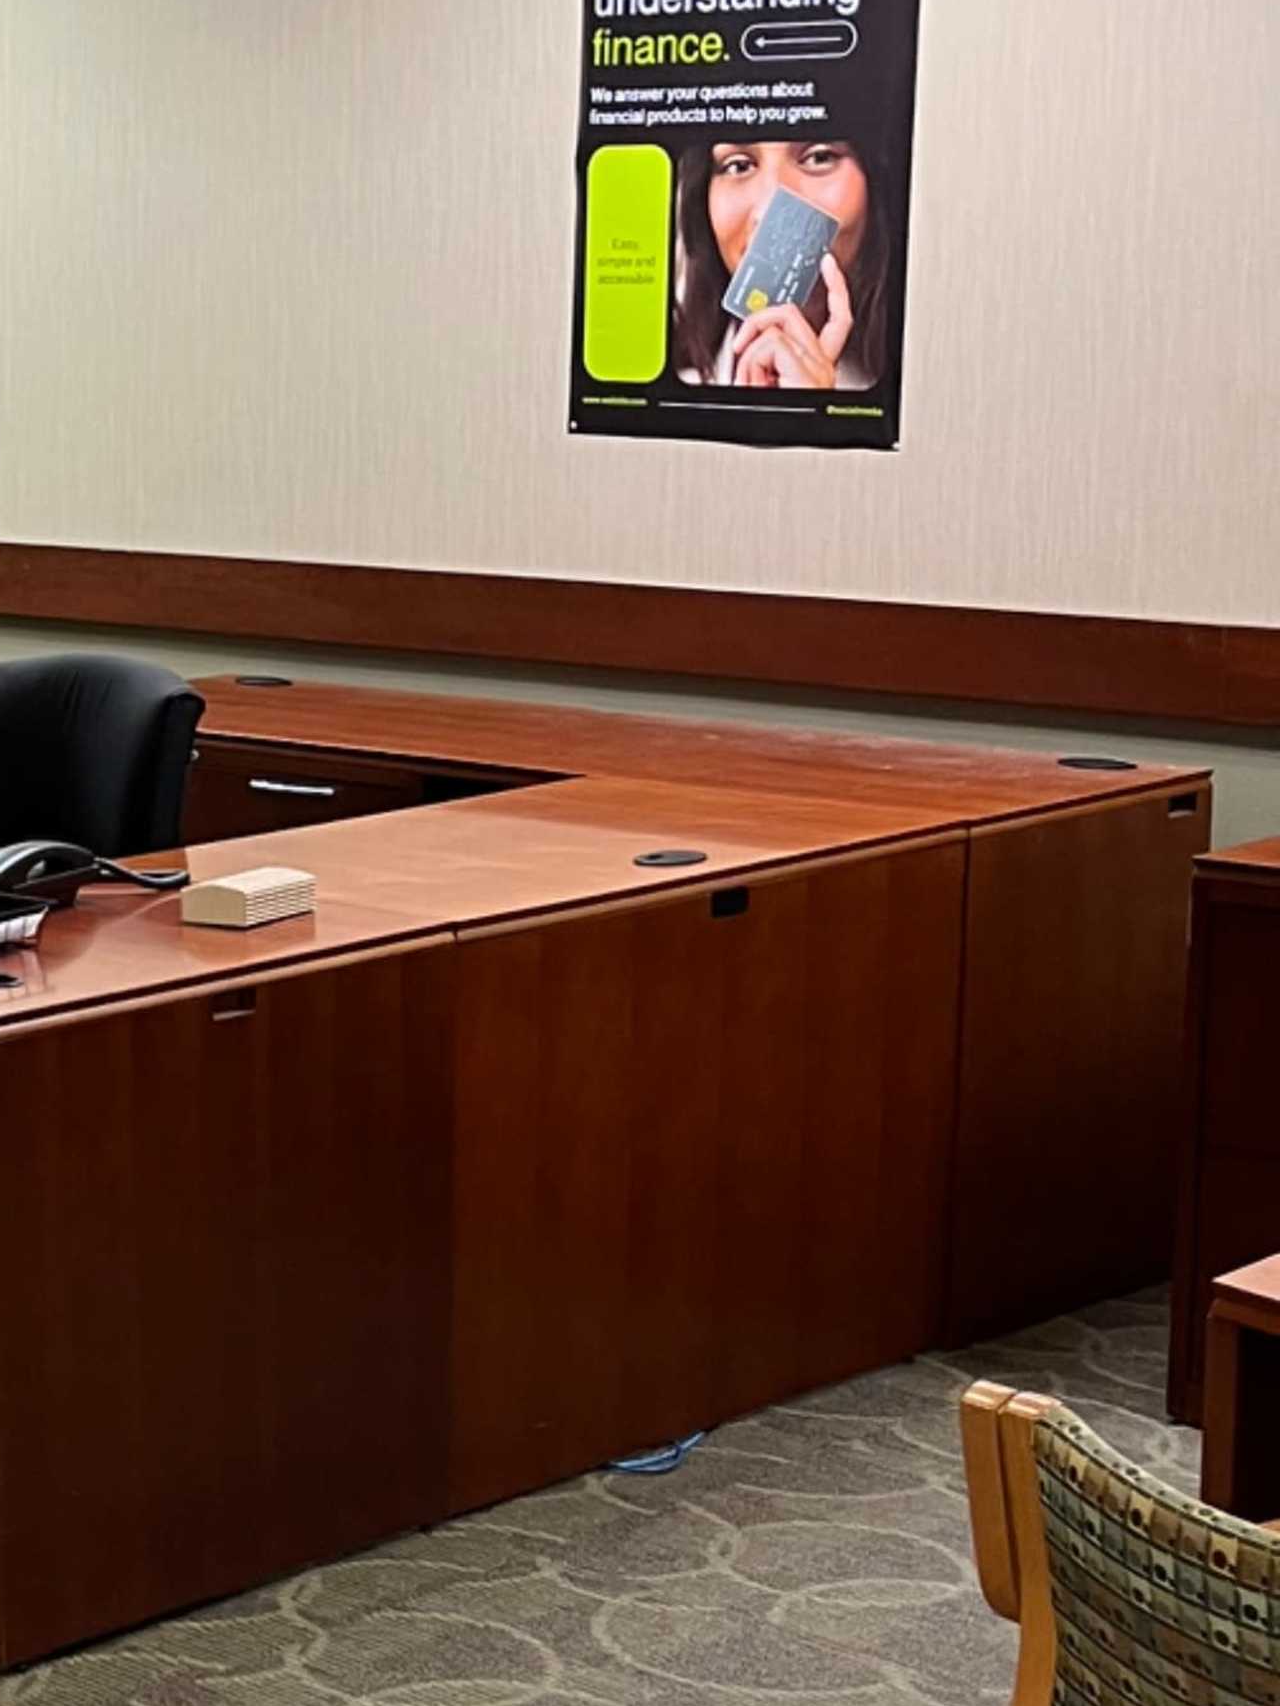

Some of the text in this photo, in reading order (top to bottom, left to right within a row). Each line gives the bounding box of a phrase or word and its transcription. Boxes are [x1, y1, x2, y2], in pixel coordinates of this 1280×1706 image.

[592, 27, 730, 66] finance.
[590, 81, 814, 104] We answer your questions about
[589, 108, 646, 125] financial
[646, 107, 707, 127] products
[709, 107, 724, 122] to
[726, 105, 757, 125] help
[758, 107, 786, 124] you
